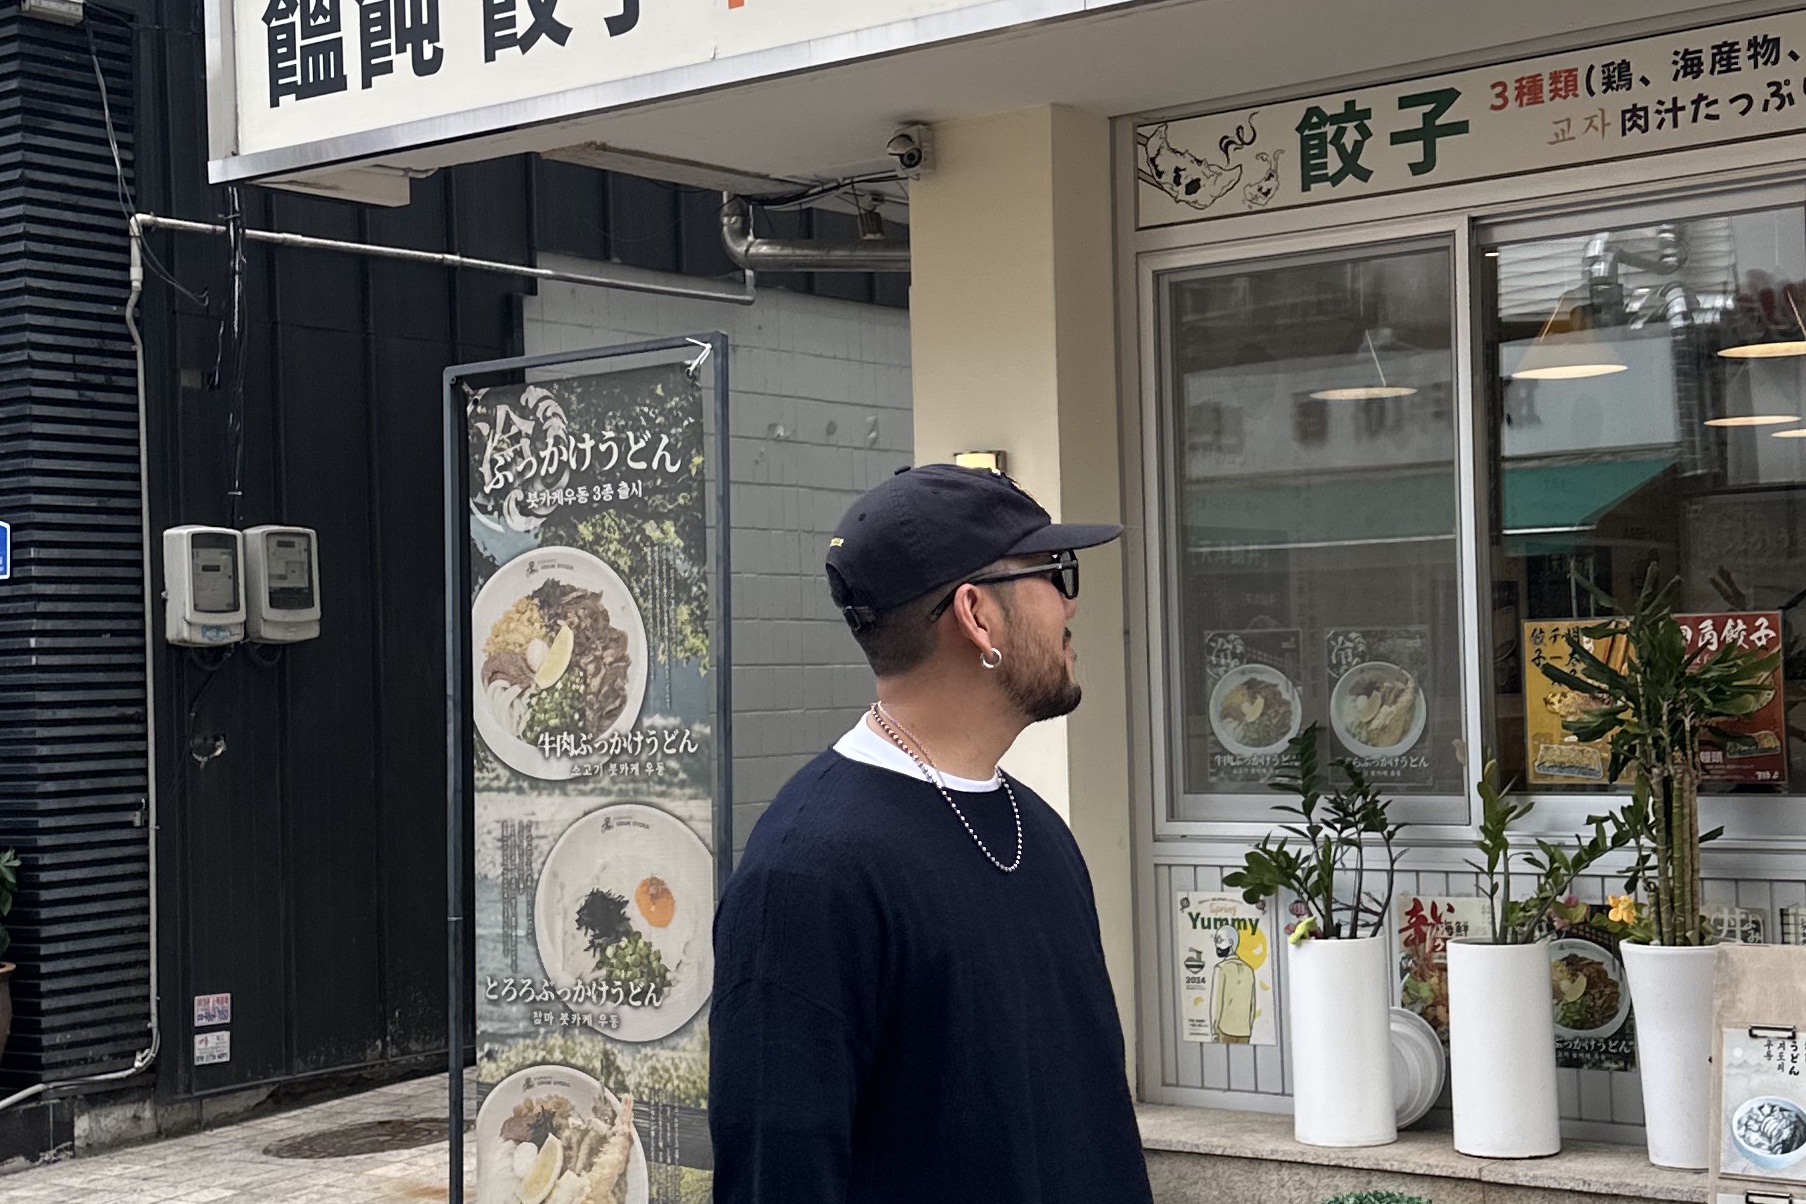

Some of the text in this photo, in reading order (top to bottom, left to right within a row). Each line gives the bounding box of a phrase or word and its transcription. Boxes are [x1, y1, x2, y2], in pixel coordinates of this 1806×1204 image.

[1620, 78, 1806, 137] 肉汁たっぷ
[1296, 86, 1470, 193] 餃子
[1547, 107, 1612, 146] 교자
[484, 430, 682, 494] ぶっかけうどん
[593, 483, 615, 502] 3종
[617, 479, 643, 500] 출시
[537, 729, 699, 758] 牛肉ぶっかけうどん
[1187, 911, 1260, 936] Yummy
[484, 975, 664, 1008] とろろぶっかけうどん
[1788, 1040, 1800, 1076] うどん
